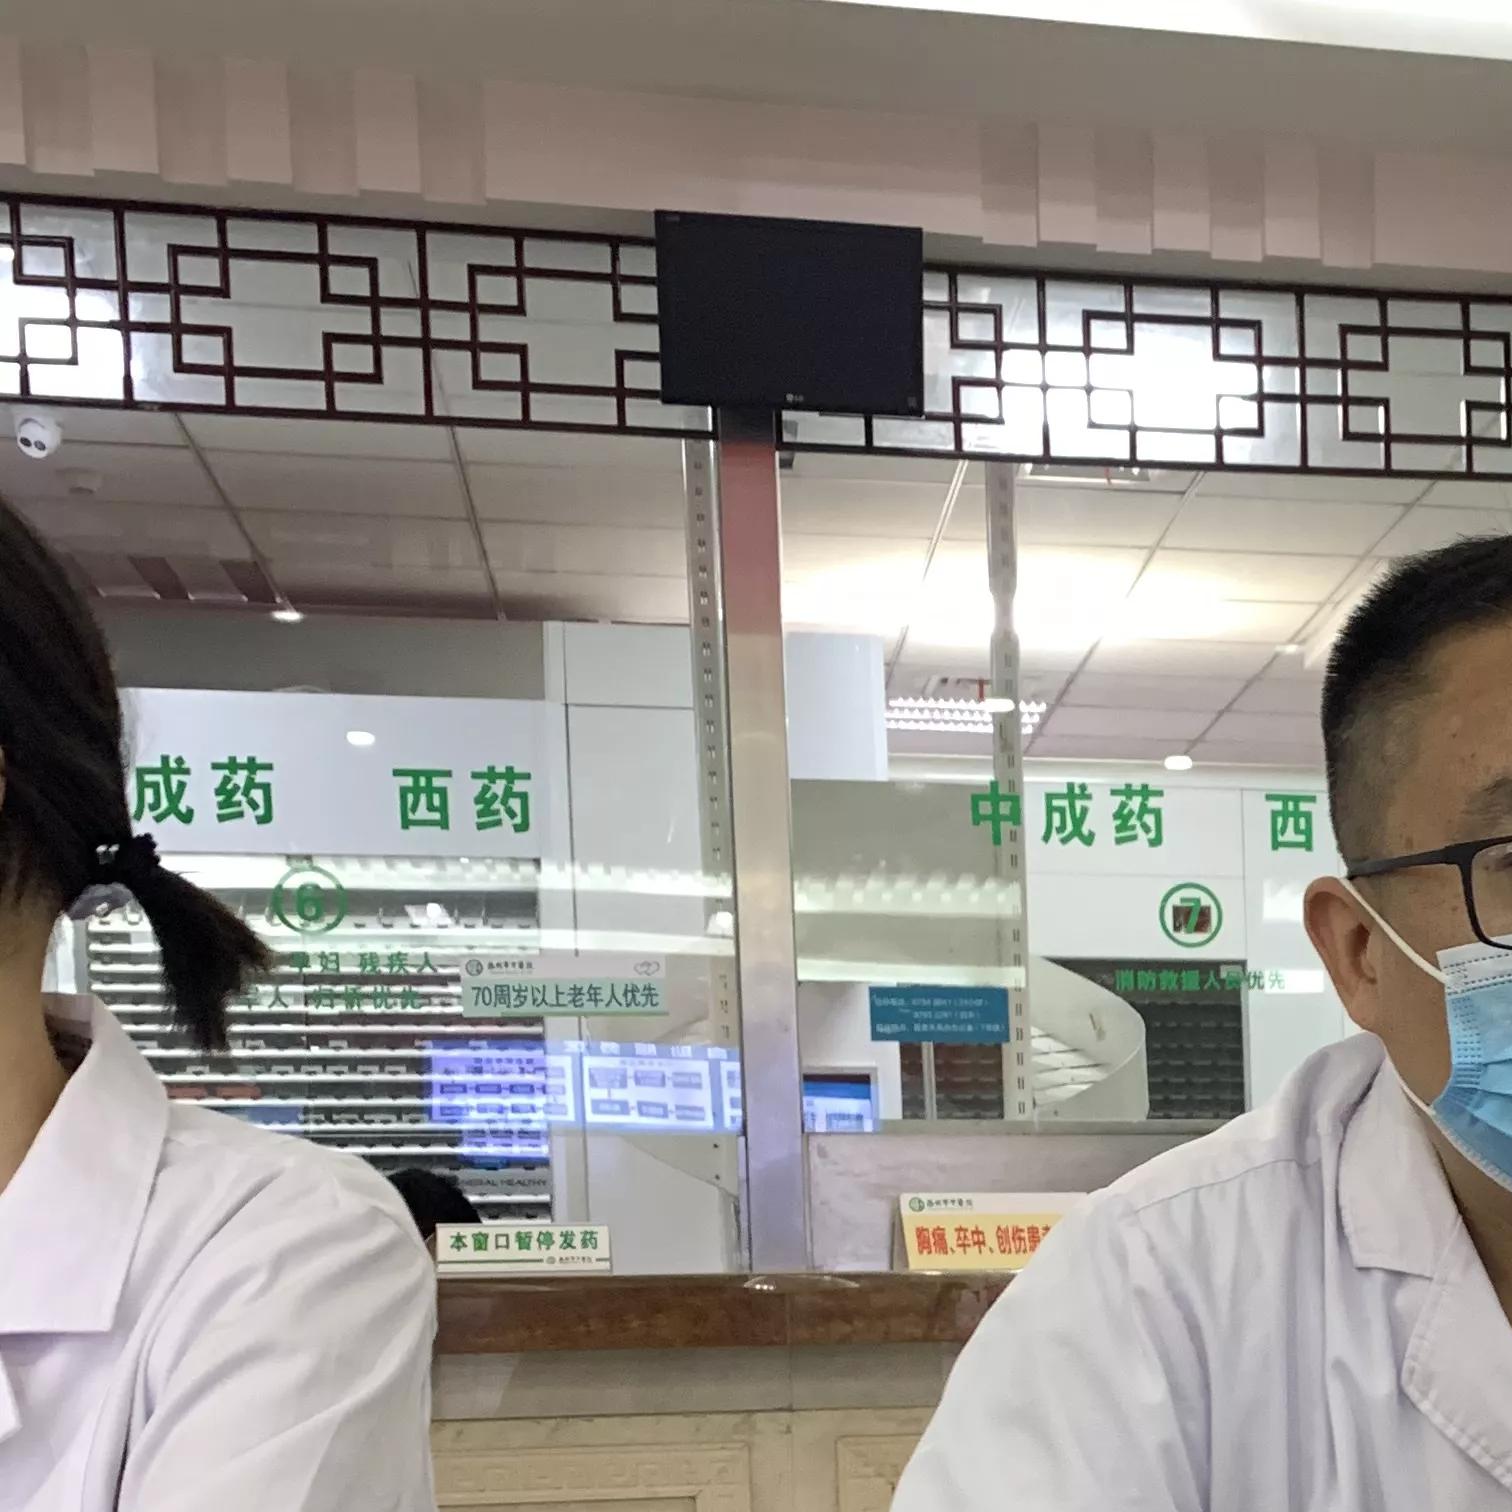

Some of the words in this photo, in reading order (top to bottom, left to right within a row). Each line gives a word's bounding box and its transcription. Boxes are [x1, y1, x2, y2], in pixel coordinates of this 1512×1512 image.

[392, 765, 531, 833] 西药
[970, 780, 1164, 848] 中成药
[1265, 793, 1317, 851] 西
[1180, 897, 1202, 934] 7
[359, 951, 438, 974] 残疾人
[471, 983, 660, 1009] 70周岁以上老年人优先
[450, 1230, 599, 1251] 本窗口暂停发药
[915, 1225, 1051, 1255] 胸痛、卒中、创伤患
